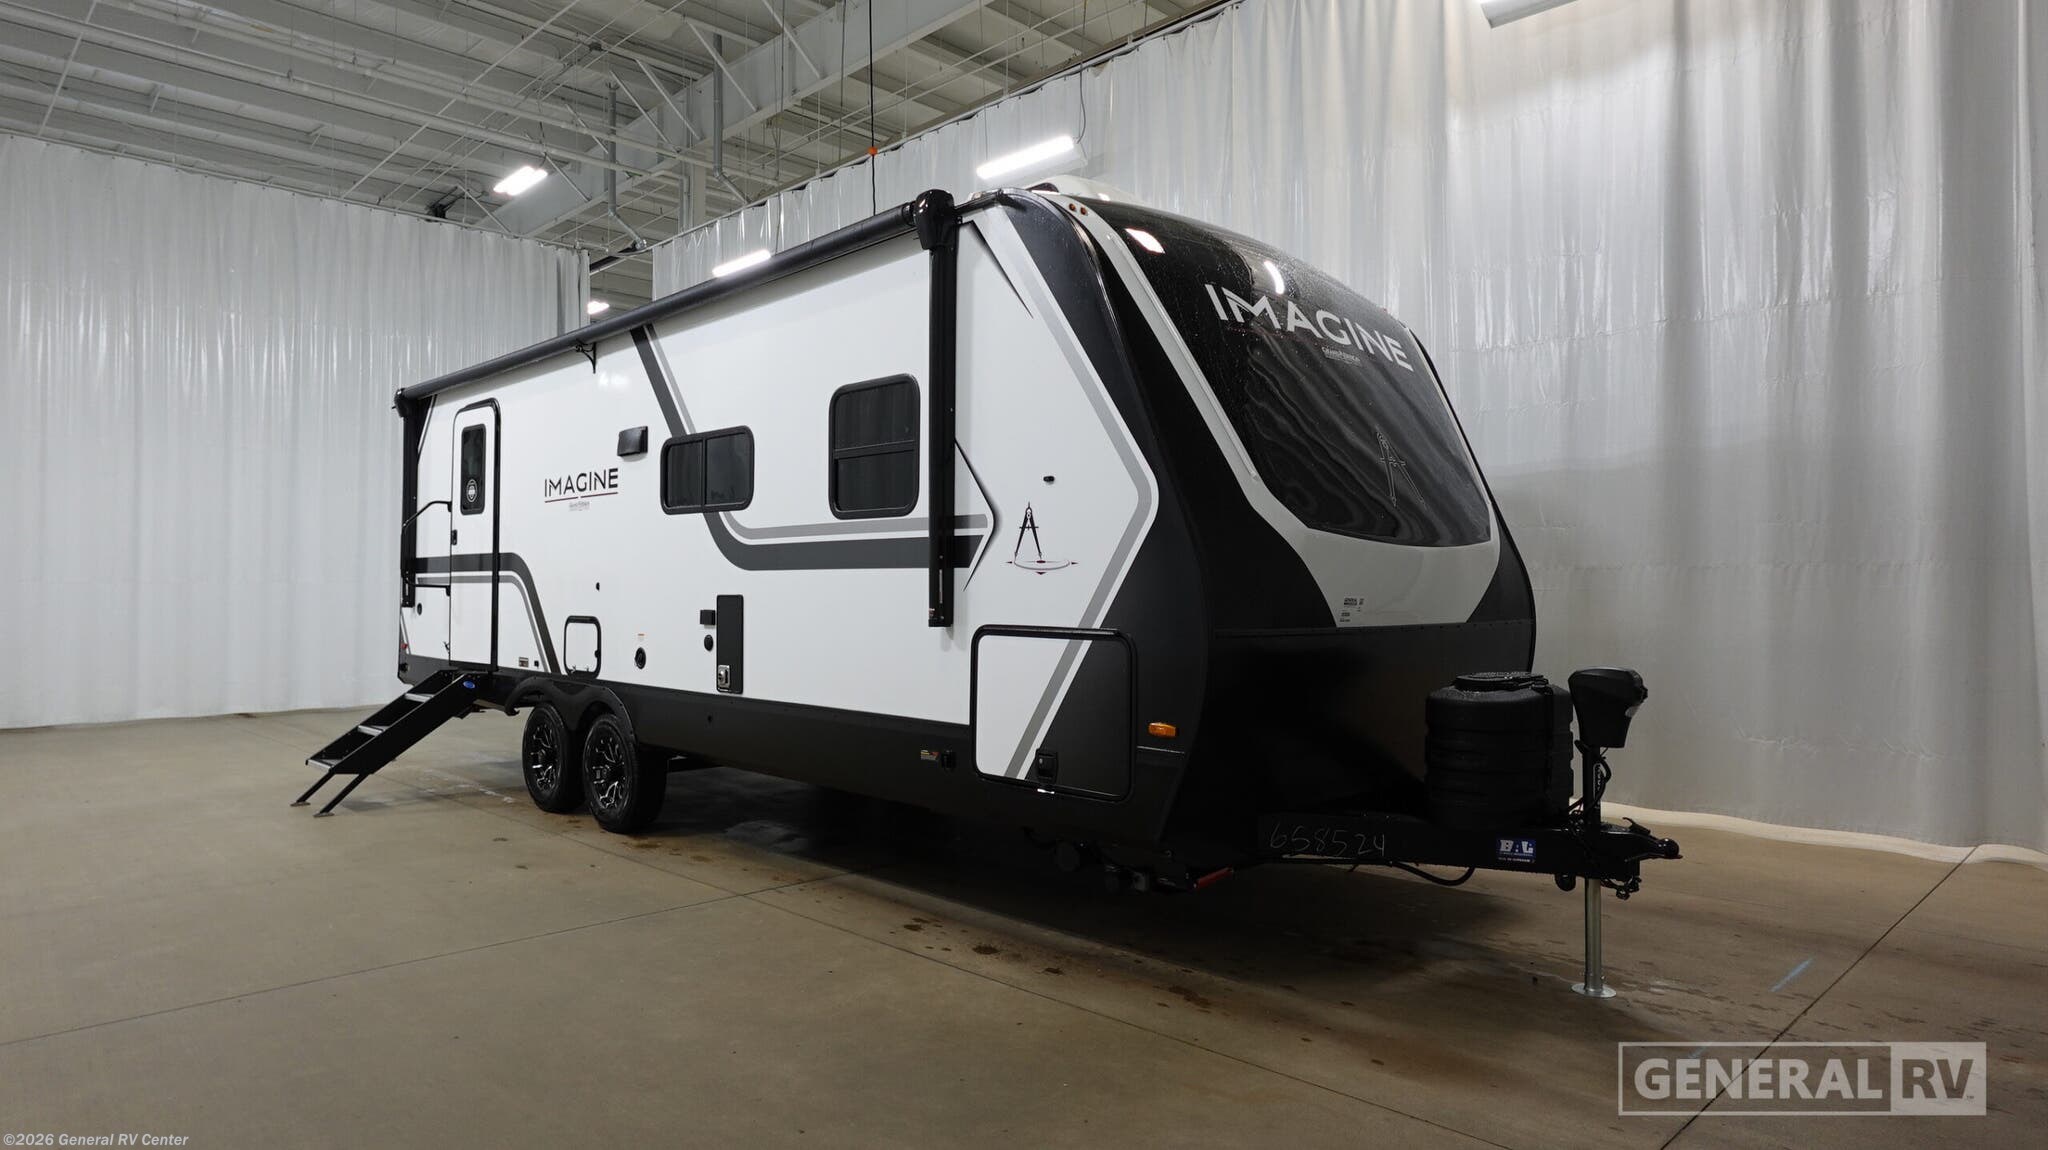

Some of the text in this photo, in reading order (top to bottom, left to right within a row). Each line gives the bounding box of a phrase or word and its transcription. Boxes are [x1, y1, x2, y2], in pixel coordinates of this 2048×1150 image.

[1205, 284, 1413, 372] IMAGINE
[544, 467, 619, 498] IMAGINE
[1270, 822, 1385, 857] 658524
